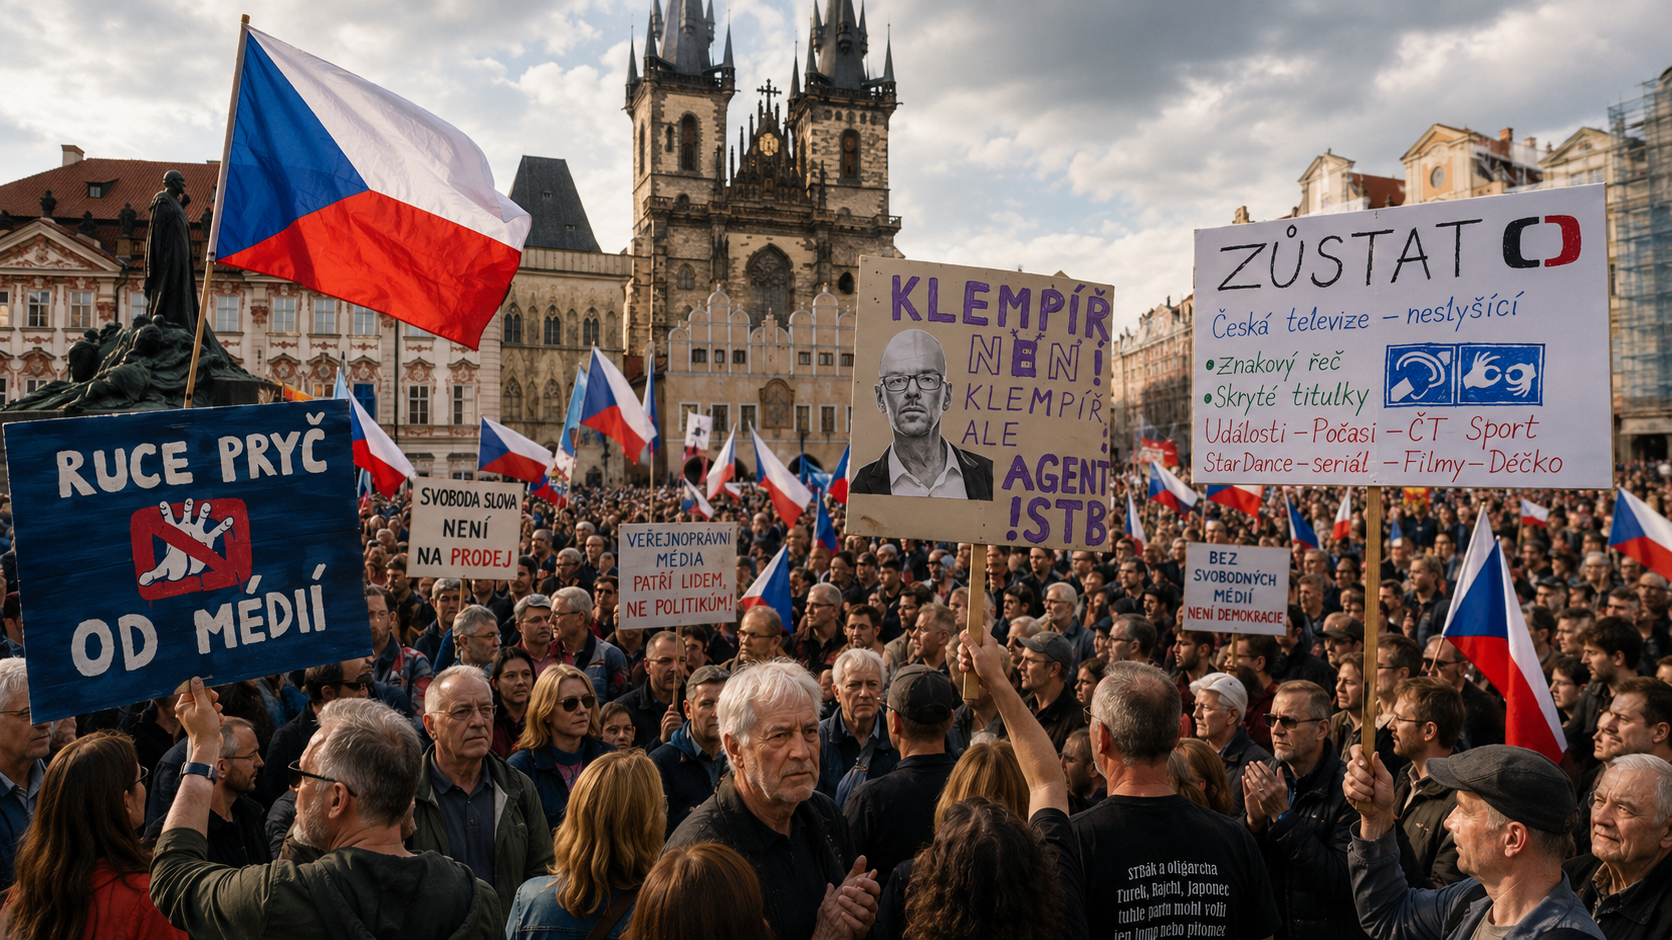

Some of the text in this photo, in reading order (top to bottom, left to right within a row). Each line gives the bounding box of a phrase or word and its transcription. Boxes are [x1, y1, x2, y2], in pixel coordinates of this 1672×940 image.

[1217, 218, 1483, 291] ZŮSTAT
[891, 274, 1110, 342] KLEMPÍŘ
[1212, 308, 1272, 339] Česká
[1286, 306, 1369, 333] televize
[1406, 291, 1525, 332] neslyšící
[1308, 350, 1345, 372] řeč
[1214, 381, 1370, 416] Skryté titulky
[961, 419, 1019, 447] ALE
[1205, 418, 1287, 444] Události
[1312, 417, 1377, 444] Počasi
[1408, 411, 1448, 441] ČT
[1466, 414, 1540, 450] Sport
[56, 411, 328, 498] RUCE PRYČ
[1001, 453, 1110, 497] AGENT
[1311, 450, 1370, 473] seriál
[1404, 450, 1466, 483] Filmy
[1489, 449, 1563, 474] Déčko
[420, 487, 518, 510] SVOBODA SLOVA
[443, 515, 492, 539] NENÍ
[626, 528, 733, 548] VEŘEJNOPRÁVNÍ
[417, 547, 512, 568] NA PRODEJ
[656, 549, 705, 568] MÉDIA
[1209, 550, 1238, 566] BEZ
[633, 570, 727, 592] PATŘÍ LIDEM,
[1193, 568, 1277, 587] SVOBODNÝCH
[1213, 587, 1255, 605] MÉDIÍ
[71, 563, 327, 677] OD MÉDIÍ
[626, 600, 648, 619] NE
[1187, 604, 1284, 624] NENÍ DEMOKRACIE
[1159, 863, 1165, 875] a
[1167, 860, 1218, 877] oligarcha
[1152, 880, 1184, 898] Rajchl,
[1187, 880, 1230, 897] Japonec
[1118, 906, 1145, 924] tuhle
[1174, 901, 1201, 916] mohl
[1160, 921, 1185, 937] nebo
